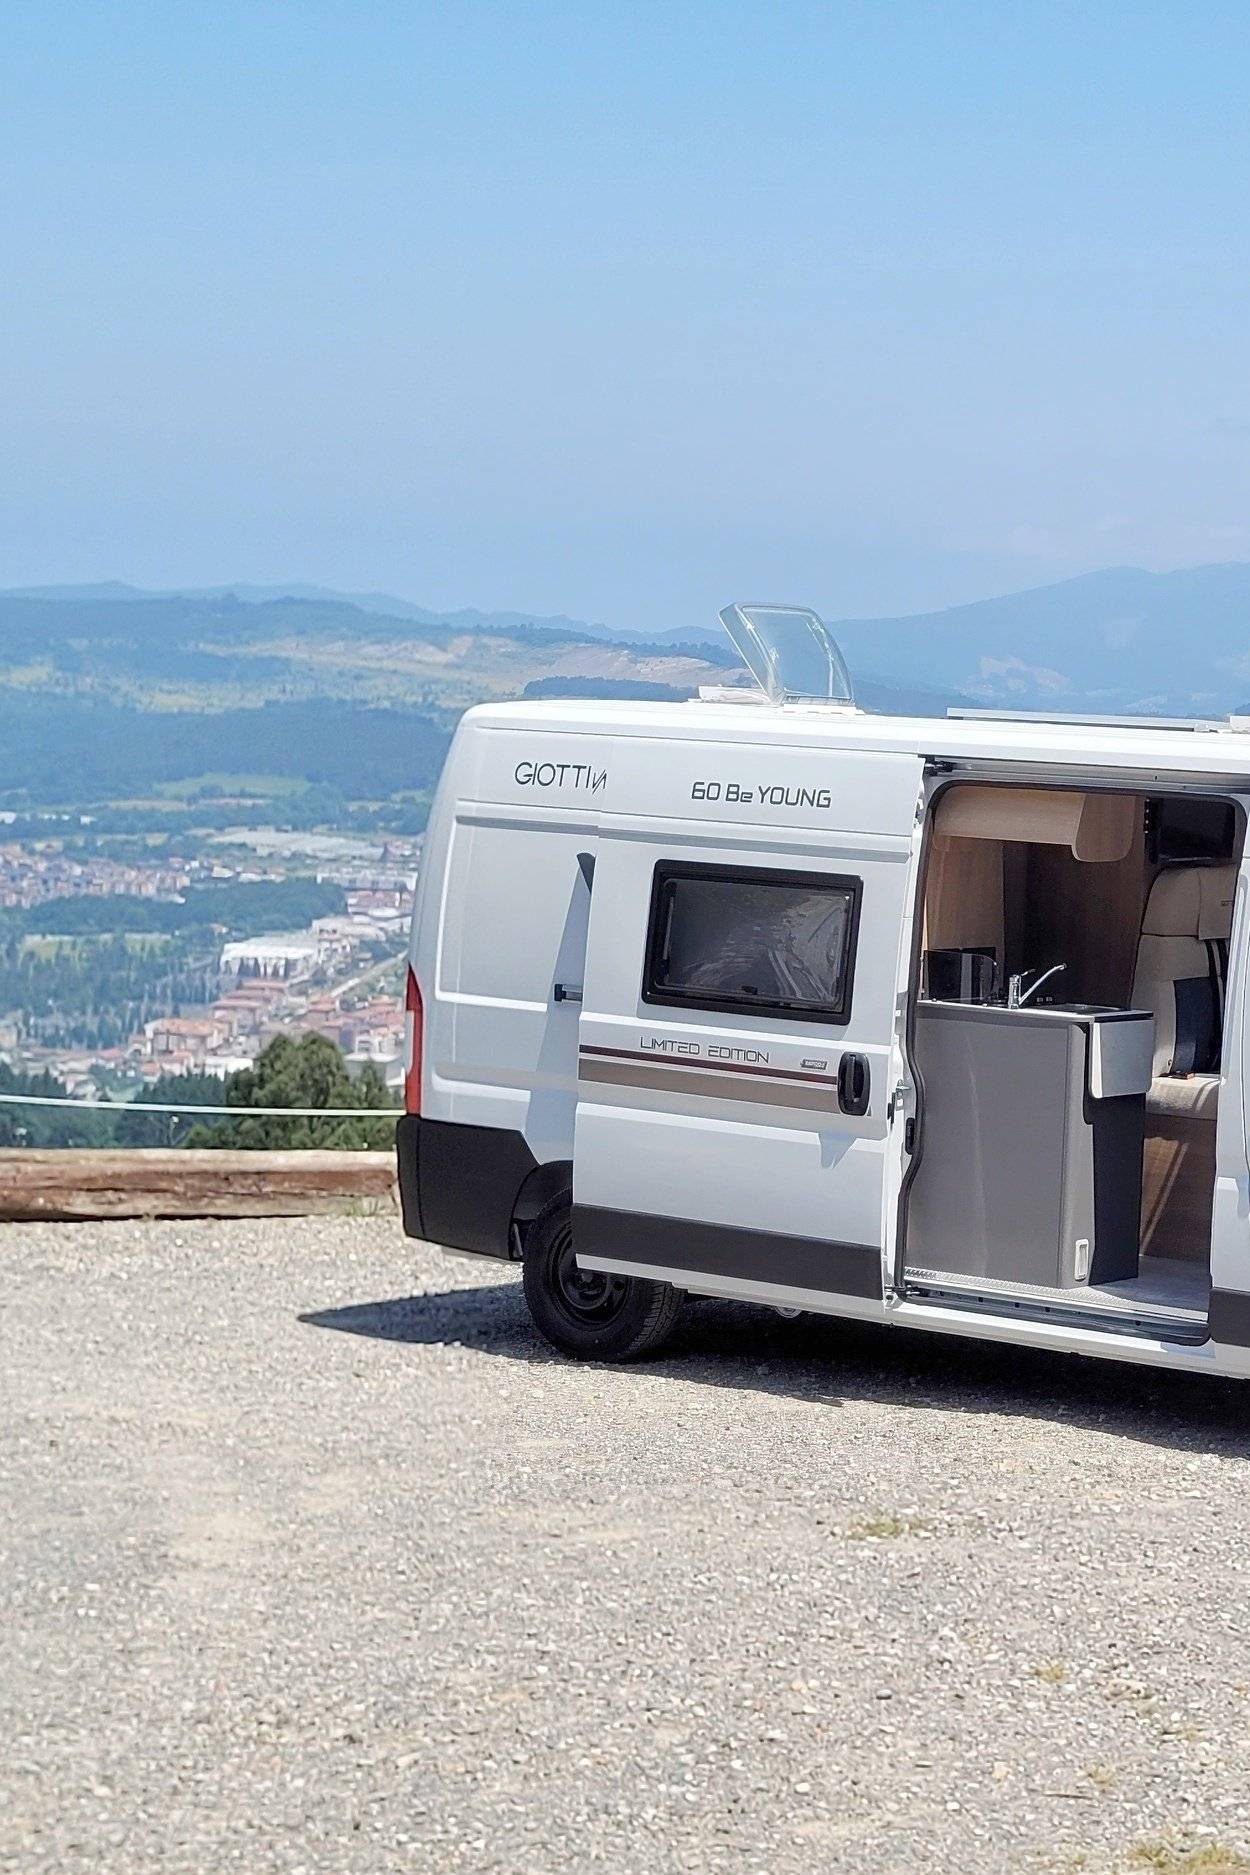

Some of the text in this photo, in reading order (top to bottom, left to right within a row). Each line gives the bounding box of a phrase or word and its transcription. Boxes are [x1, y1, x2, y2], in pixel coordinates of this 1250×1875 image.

[691, 781, 832, 808] 60 Be YOUNG
[640, 1036, 769, 1064] LIMITED EDITION
